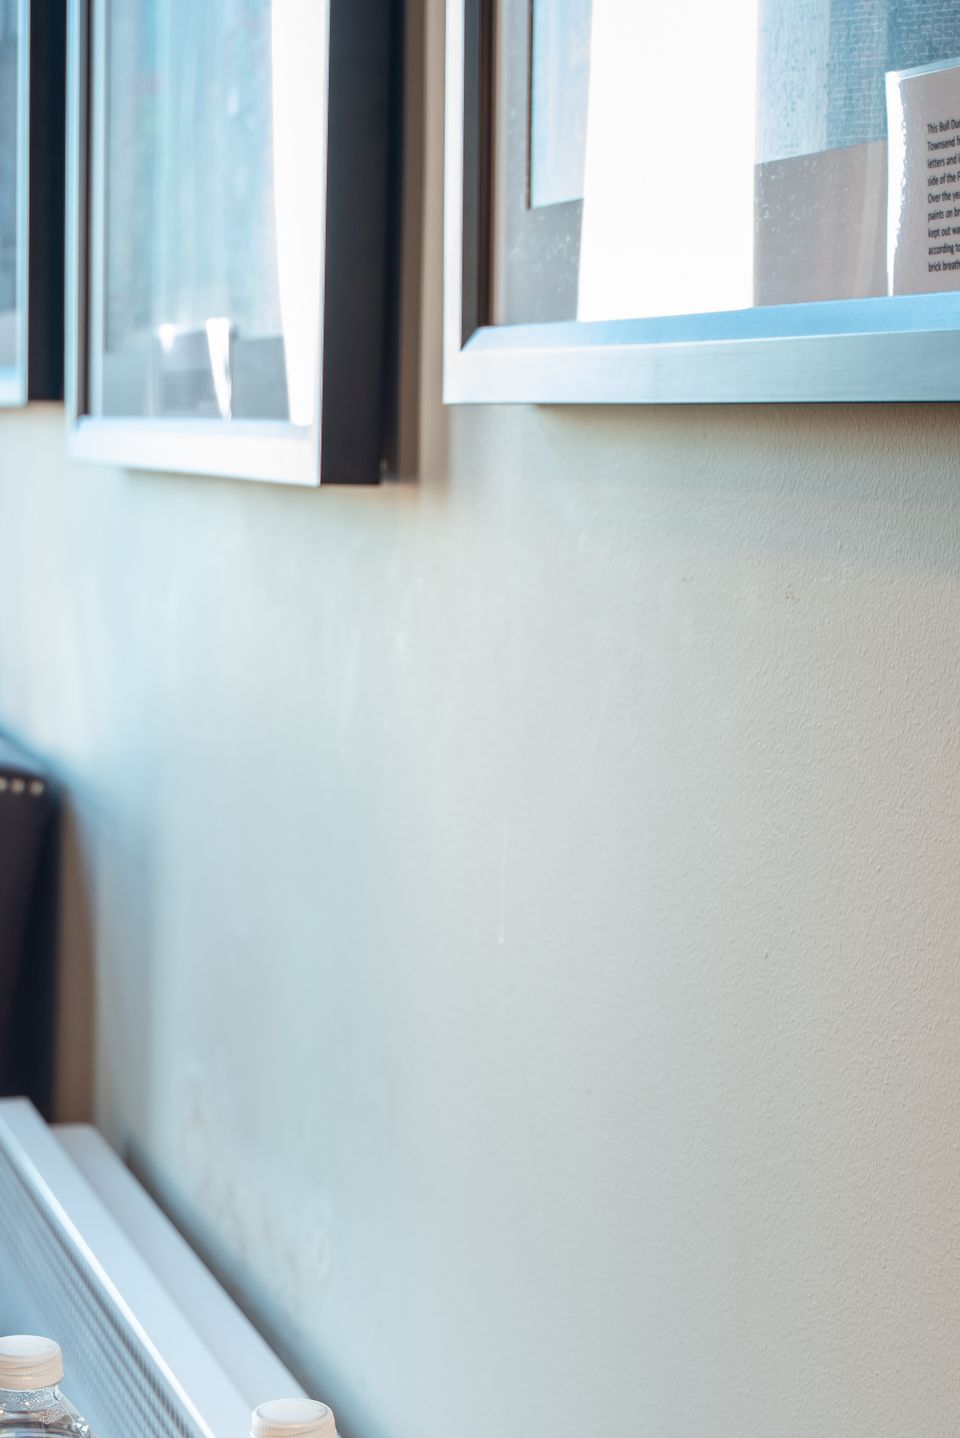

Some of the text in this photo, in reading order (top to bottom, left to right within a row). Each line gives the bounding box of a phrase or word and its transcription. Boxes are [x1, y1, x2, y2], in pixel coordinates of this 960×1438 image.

[927, 123, 938, 134] This
[939, 120, 950, 132] Bull
[927, 136, 955, 151] Townsend
[927, 157, 945, 169] letters
[946, 153, 957, 166] and
[927, 175, 939, 187] side
[940, 172, 946, 184] of
[947, 171, 956, 183] the
[927, 193, 941, 204] Over
[942, 190, 951, 202] the
[927, 209, 944, 223] paints
[945, 209, 953, 218] on
[927, 227, 940, 239] kept
[941, 226, 951, 237] out
[927, 242, 954, 256] according
[927, 260, 941, 273] brick
